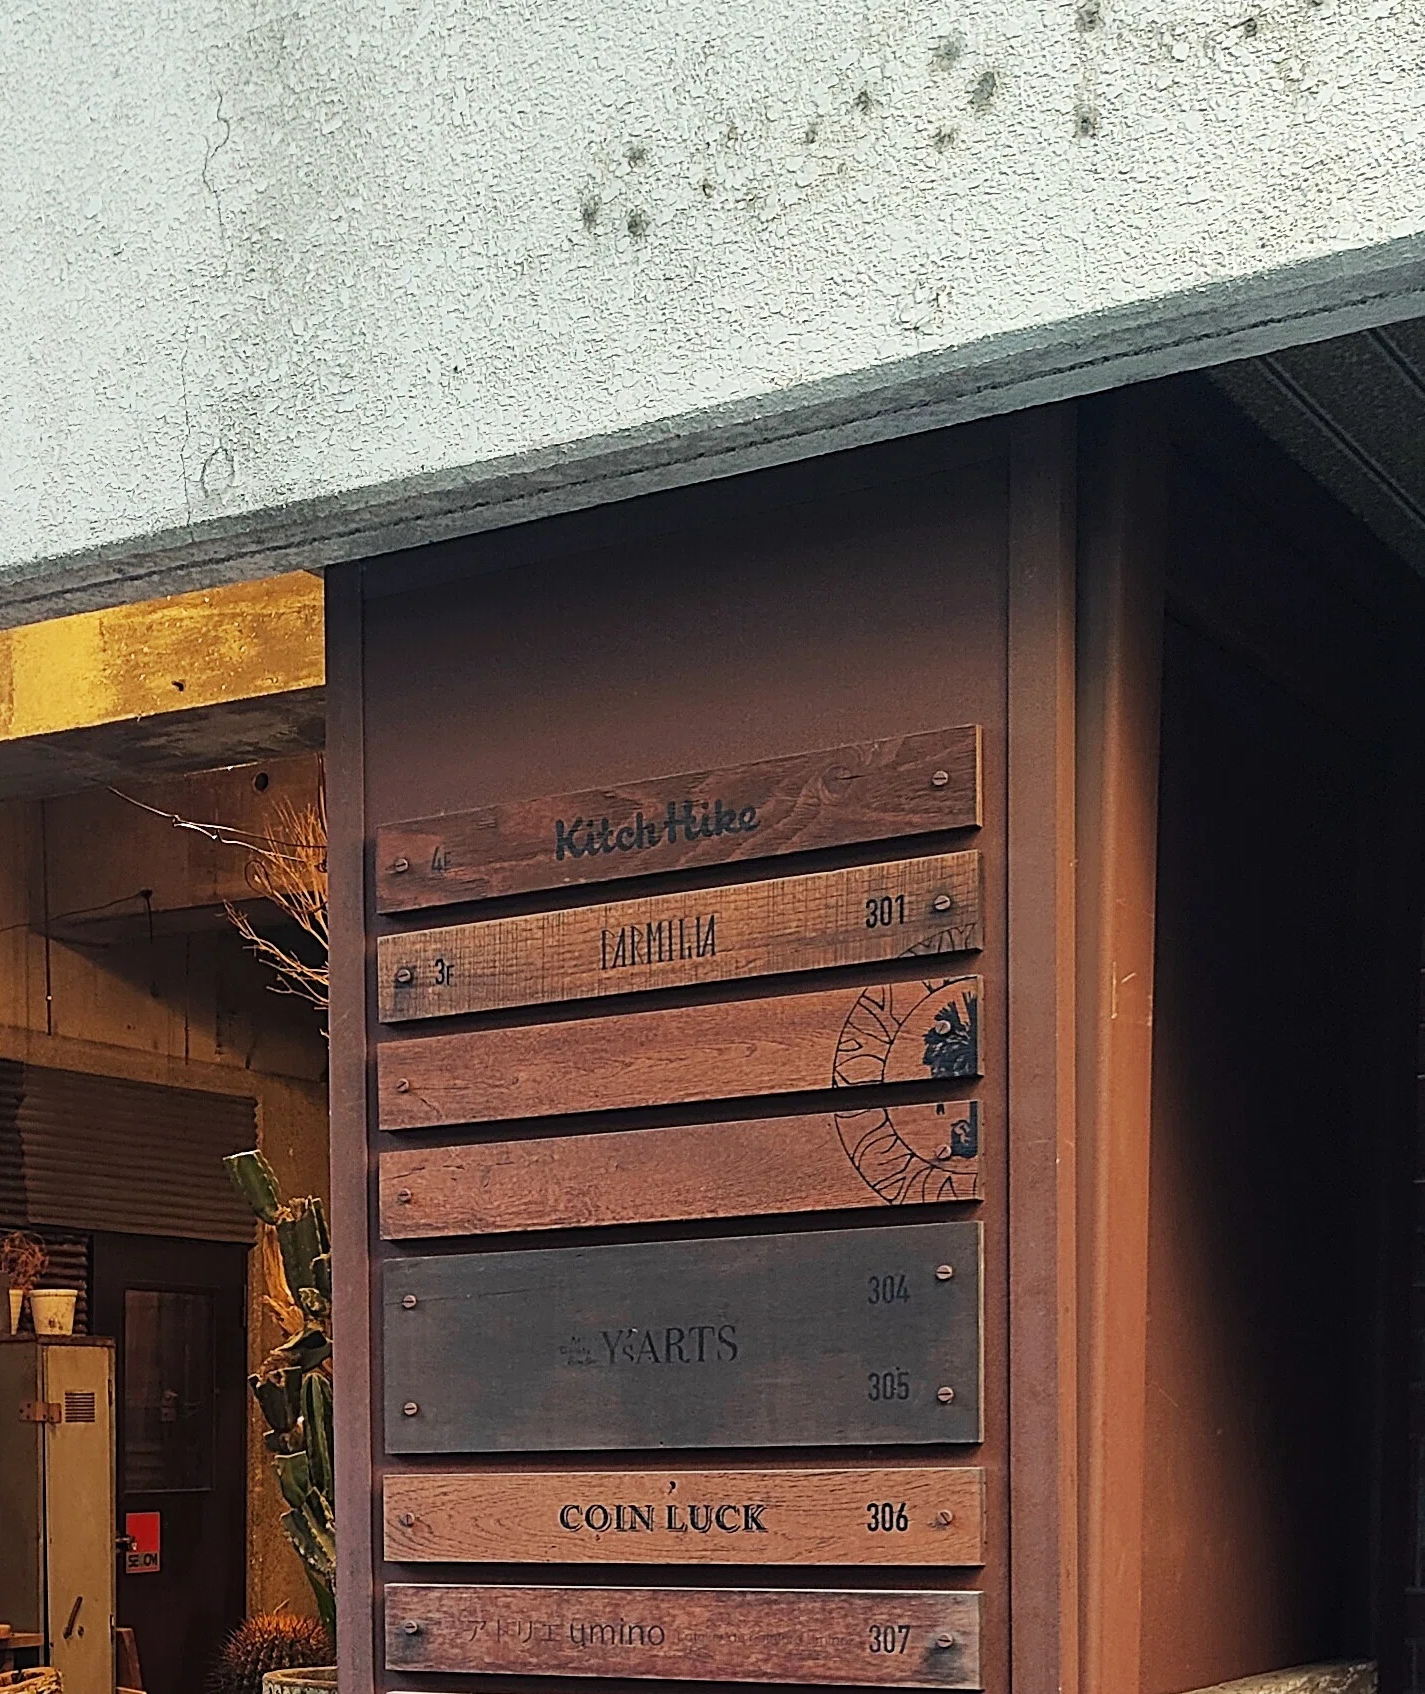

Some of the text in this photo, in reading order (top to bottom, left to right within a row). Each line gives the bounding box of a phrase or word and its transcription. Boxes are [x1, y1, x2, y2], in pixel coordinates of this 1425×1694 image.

[555, 800, 761, 861] KitchHike
[865, 893, 905, 929] 301
[435, 958, 455, 986] 3F
[868, 1274, 910, 1304] 304
[868, 1371, 910, 1401] 305
[866, 1502, 909, 1532] 306
[868, 1625, 911, 1654] 307
